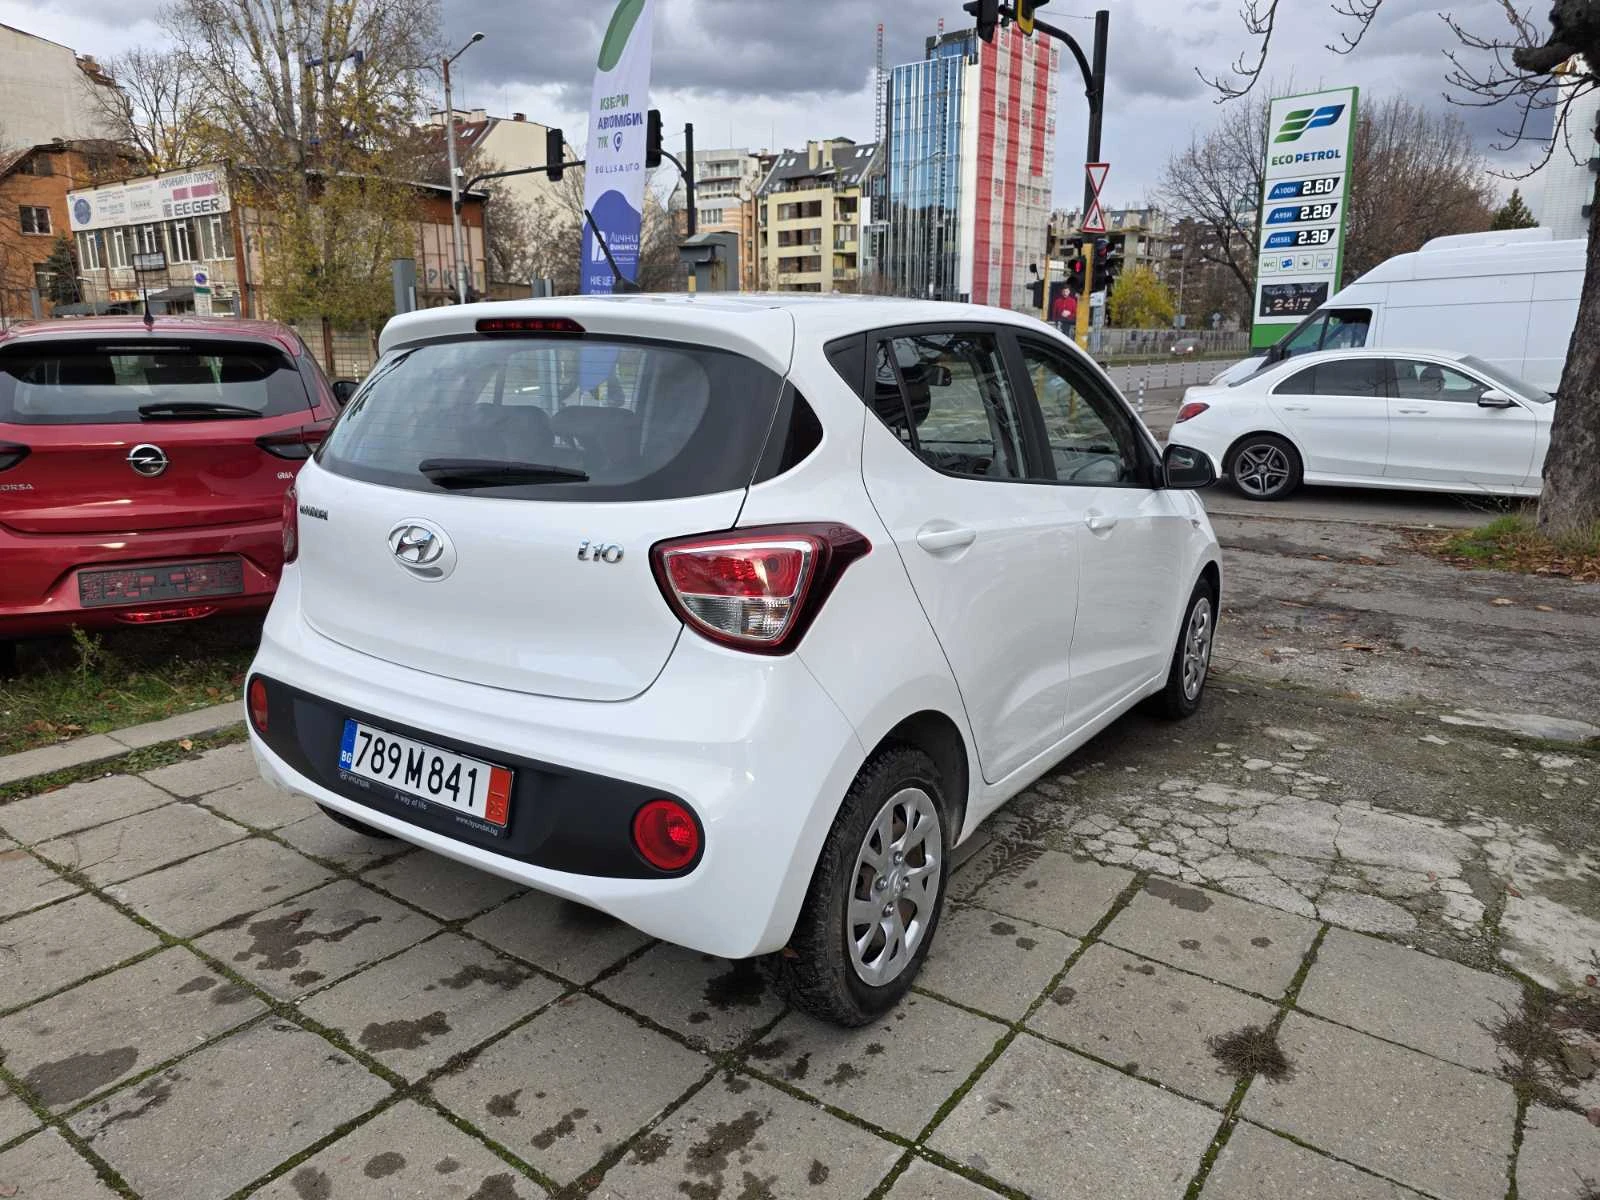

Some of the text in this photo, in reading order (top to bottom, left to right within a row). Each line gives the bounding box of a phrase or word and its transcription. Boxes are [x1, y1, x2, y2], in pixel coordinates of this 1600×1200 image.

[1272, 149, 1341, 166] ECOPETROL
[1302, 179, 1334, 195] 2.60
[174, 198, 220, 216] EGGER
[1300, 204, 1332, 220] 2.28
[1298, 230, 1329, 244] 2.38
[1273, 297, 1311, 311] 24/7
[577, 539, 624, 564] i10
[341, 750, 352, 763] BG
[355, 731, 478, 807] 789M841
